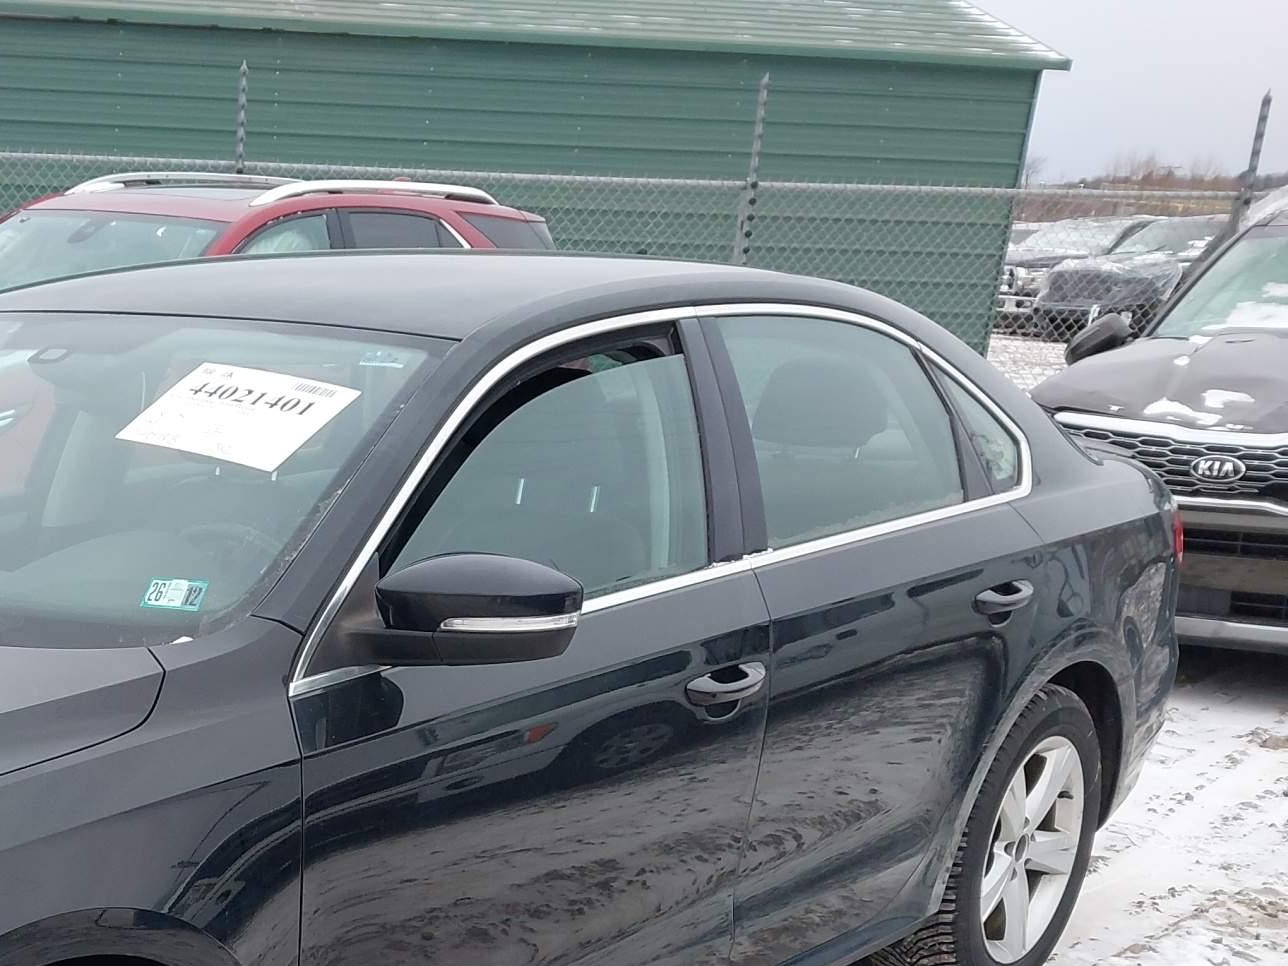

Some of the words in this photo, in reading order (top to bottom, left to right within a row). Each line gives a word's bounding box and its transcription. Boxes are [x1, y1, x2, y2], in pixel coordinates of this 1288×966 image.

[188, 382, 316, 416] 44021401
[1197, 460, 1235, 477] KIA
[147, 582, 166, 602] 26
[184, 585, 203, 607] 12
